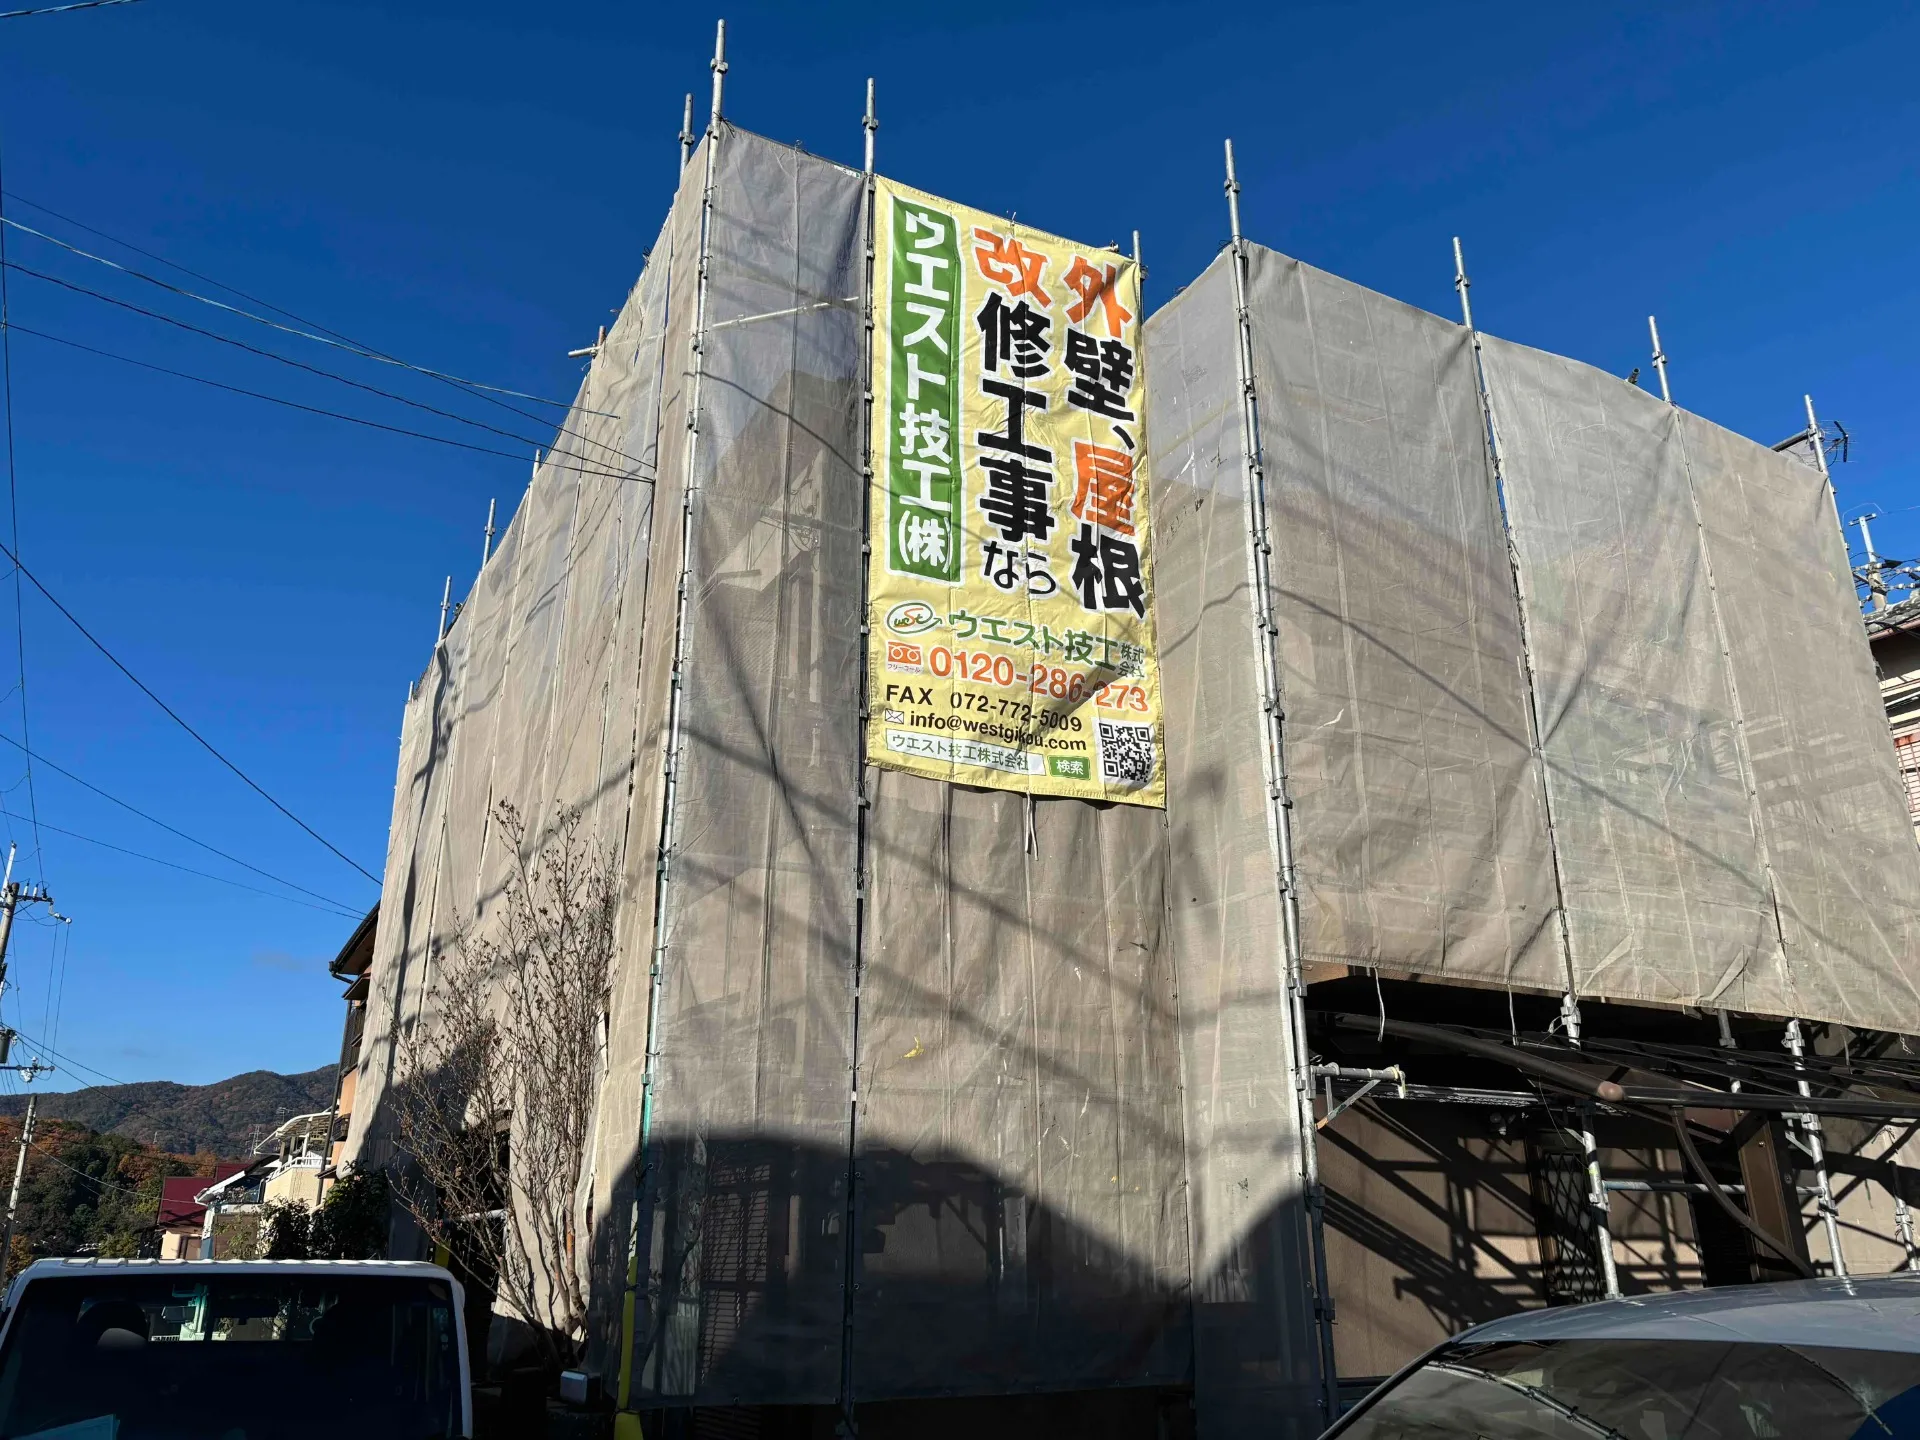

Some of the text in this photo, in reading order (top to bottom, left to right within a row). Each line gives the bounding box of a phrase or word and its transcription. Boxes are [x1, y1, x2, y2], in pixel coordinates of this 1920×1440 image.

[973, 228, 1056, 595] 改修工事なら
[1063, 258, 1146, 619] 外壁、屋根
[949, 610, 1118, 671] ウエスト技工
[930, 646, 1149, 712] 0120-286-273
[886, 685, 1083, 732] FAX 072-772-5009
[909, 714, 1087, 751] info@westgikou.com
[892, 735, 1029, 771] ウエスト技工株式会社
[1056, 760, 1085, 776] 検索
